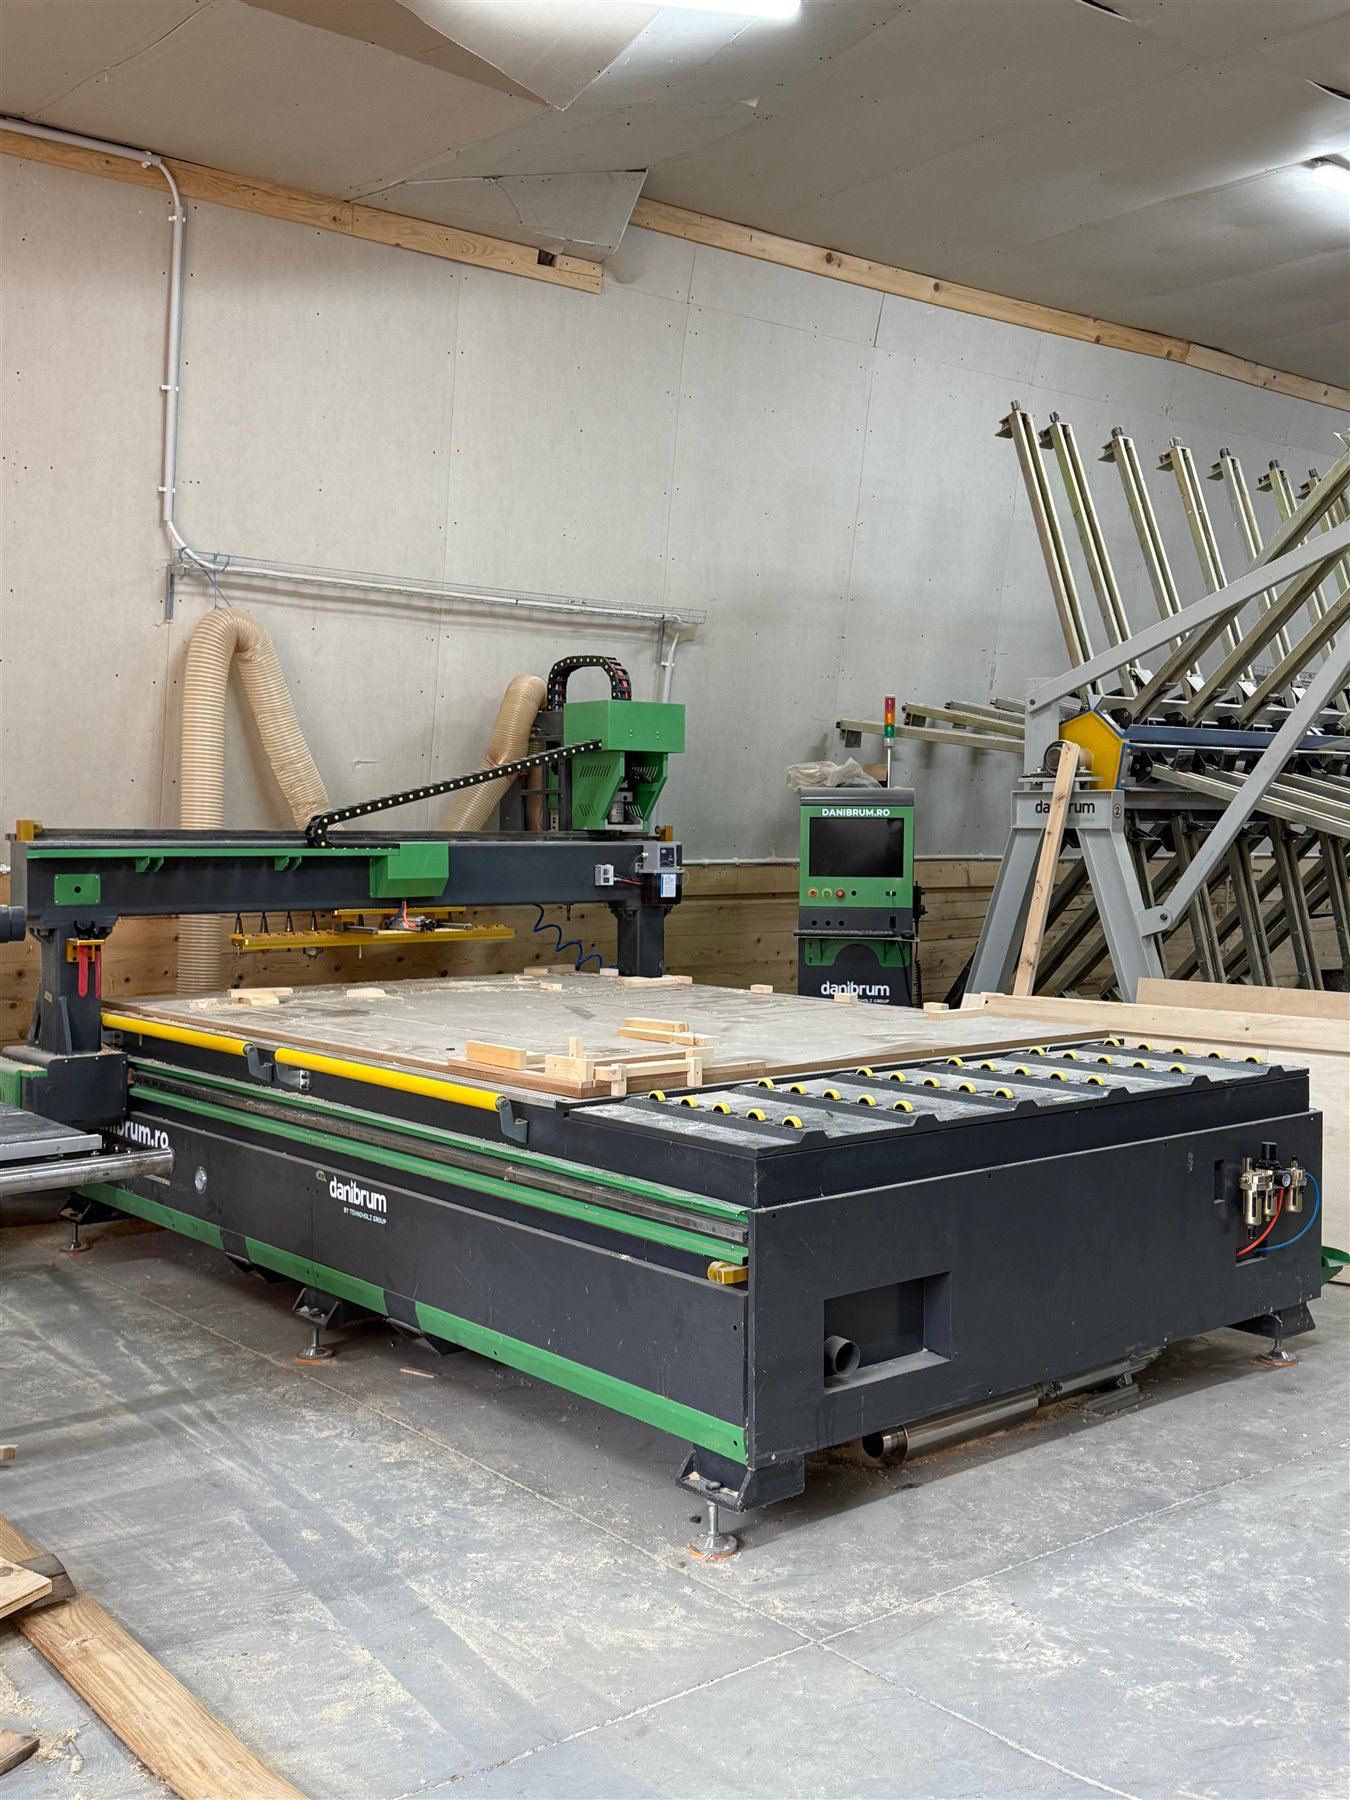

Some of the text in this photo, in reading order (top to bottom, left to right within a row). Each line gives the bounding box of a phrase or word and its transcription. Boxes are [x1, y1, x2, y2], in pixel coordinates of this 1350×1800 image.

[822, 808, 890, 817] DANIBRUM.RO
[1035, 800, 1095, 814] darum
[820, 980, 890, 996] danibrum
[329, 1175, 387, 1213] danibrum
[343, 1206, 349, 1214] BY
[373, 1214, 387, 1225] GROUP
